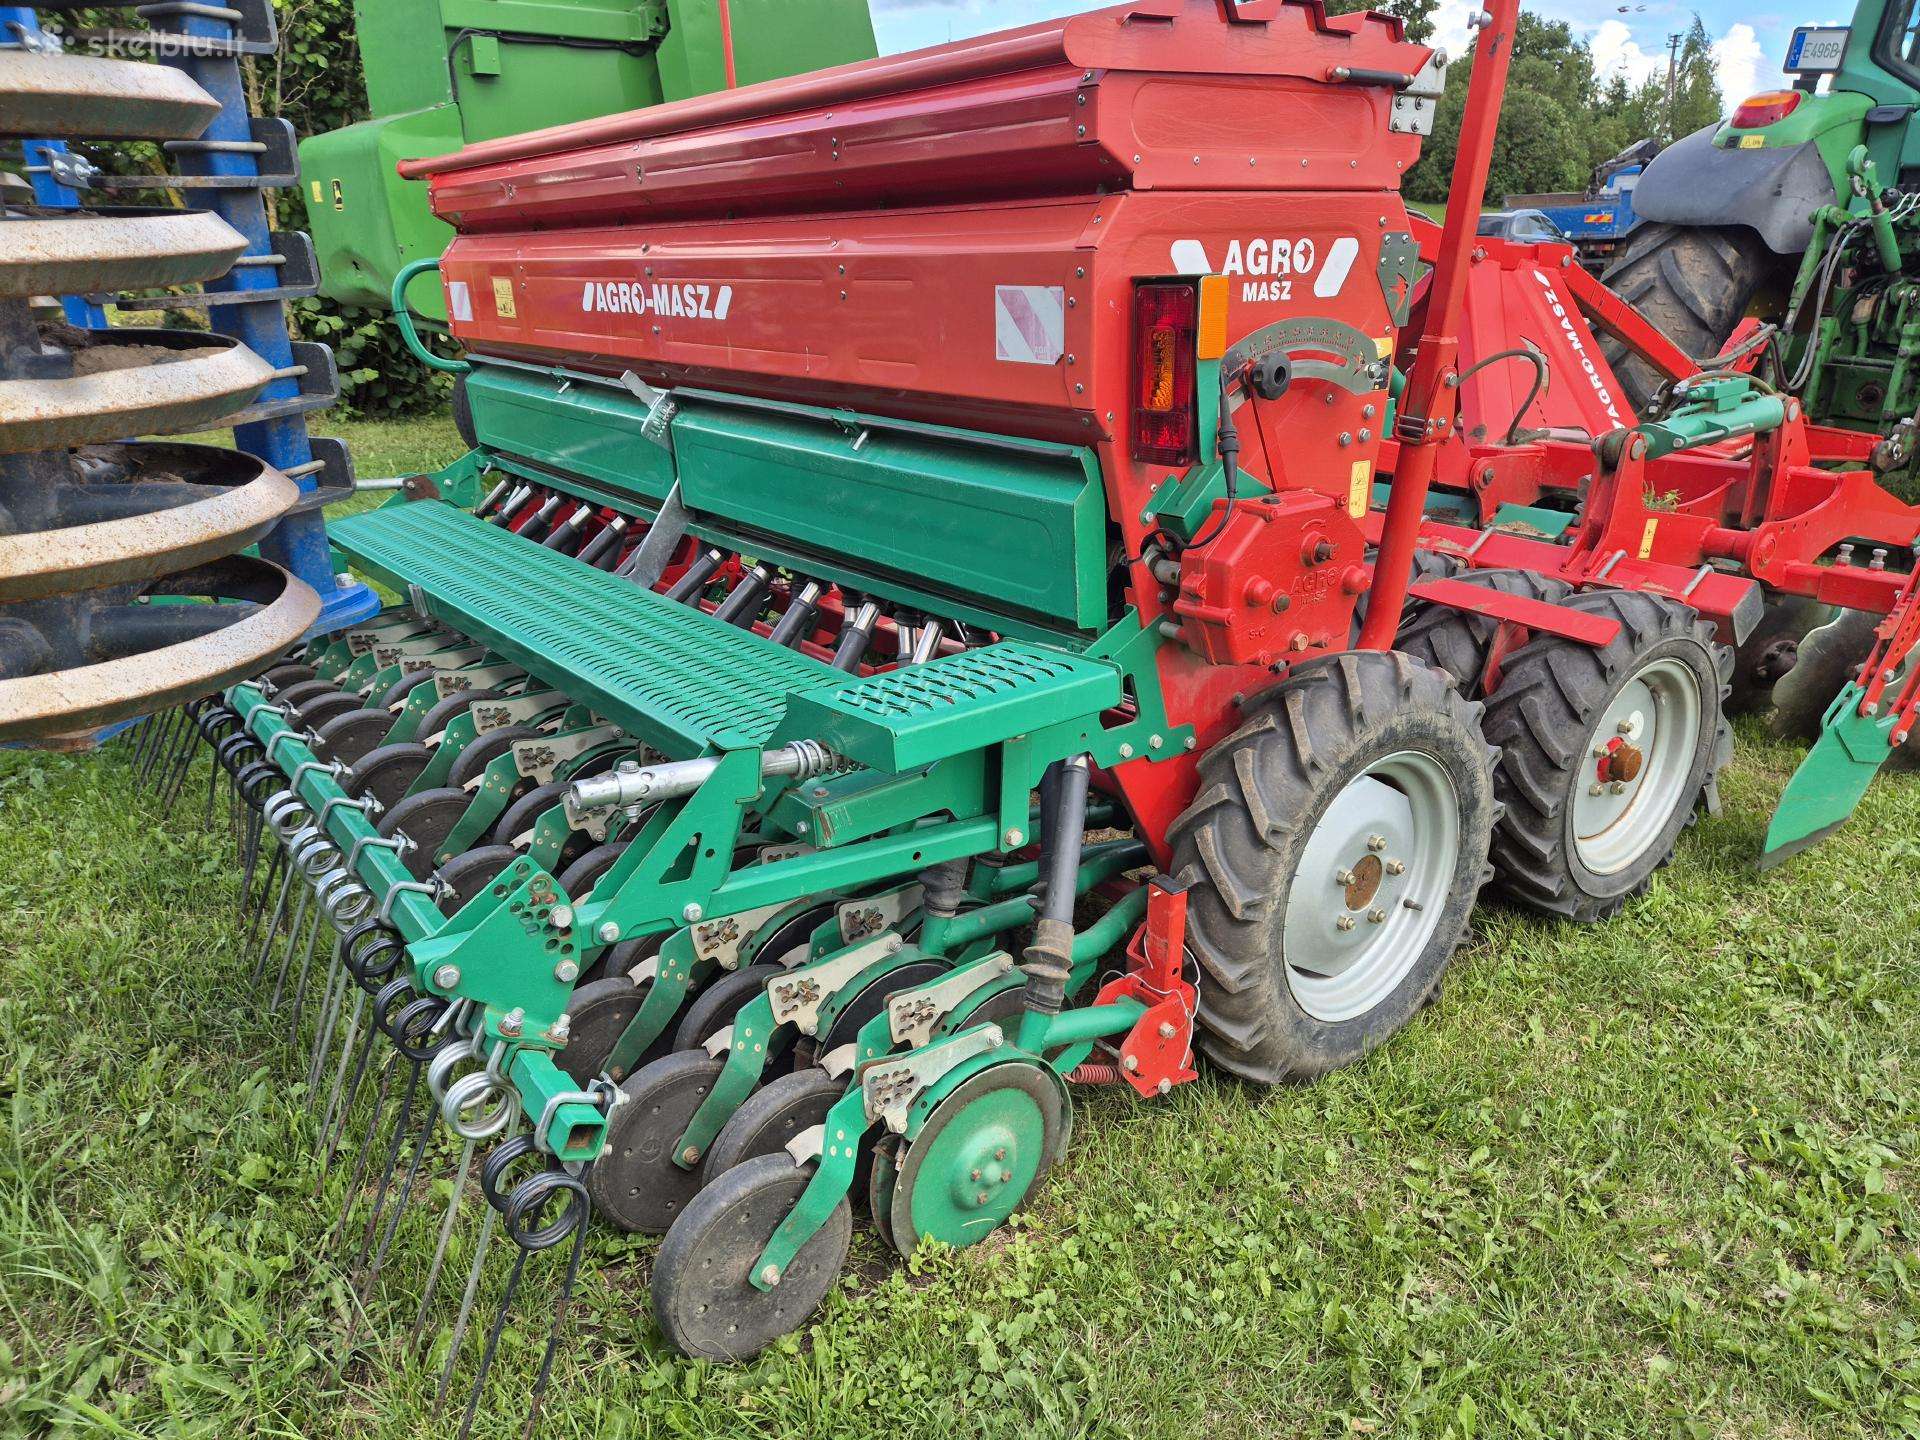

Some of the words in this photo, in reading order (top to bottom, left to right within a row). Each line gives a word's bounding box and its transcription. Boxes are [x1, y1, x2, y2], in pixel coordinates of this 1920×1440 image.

[1221, 237, 1316, 277] AGRO
[595, 281, 713, 319] AGRO-MASZ
[1242, 280, 1292, 303] MASZ
[1543, 288, 1620, 419] AGRO-MASZ
